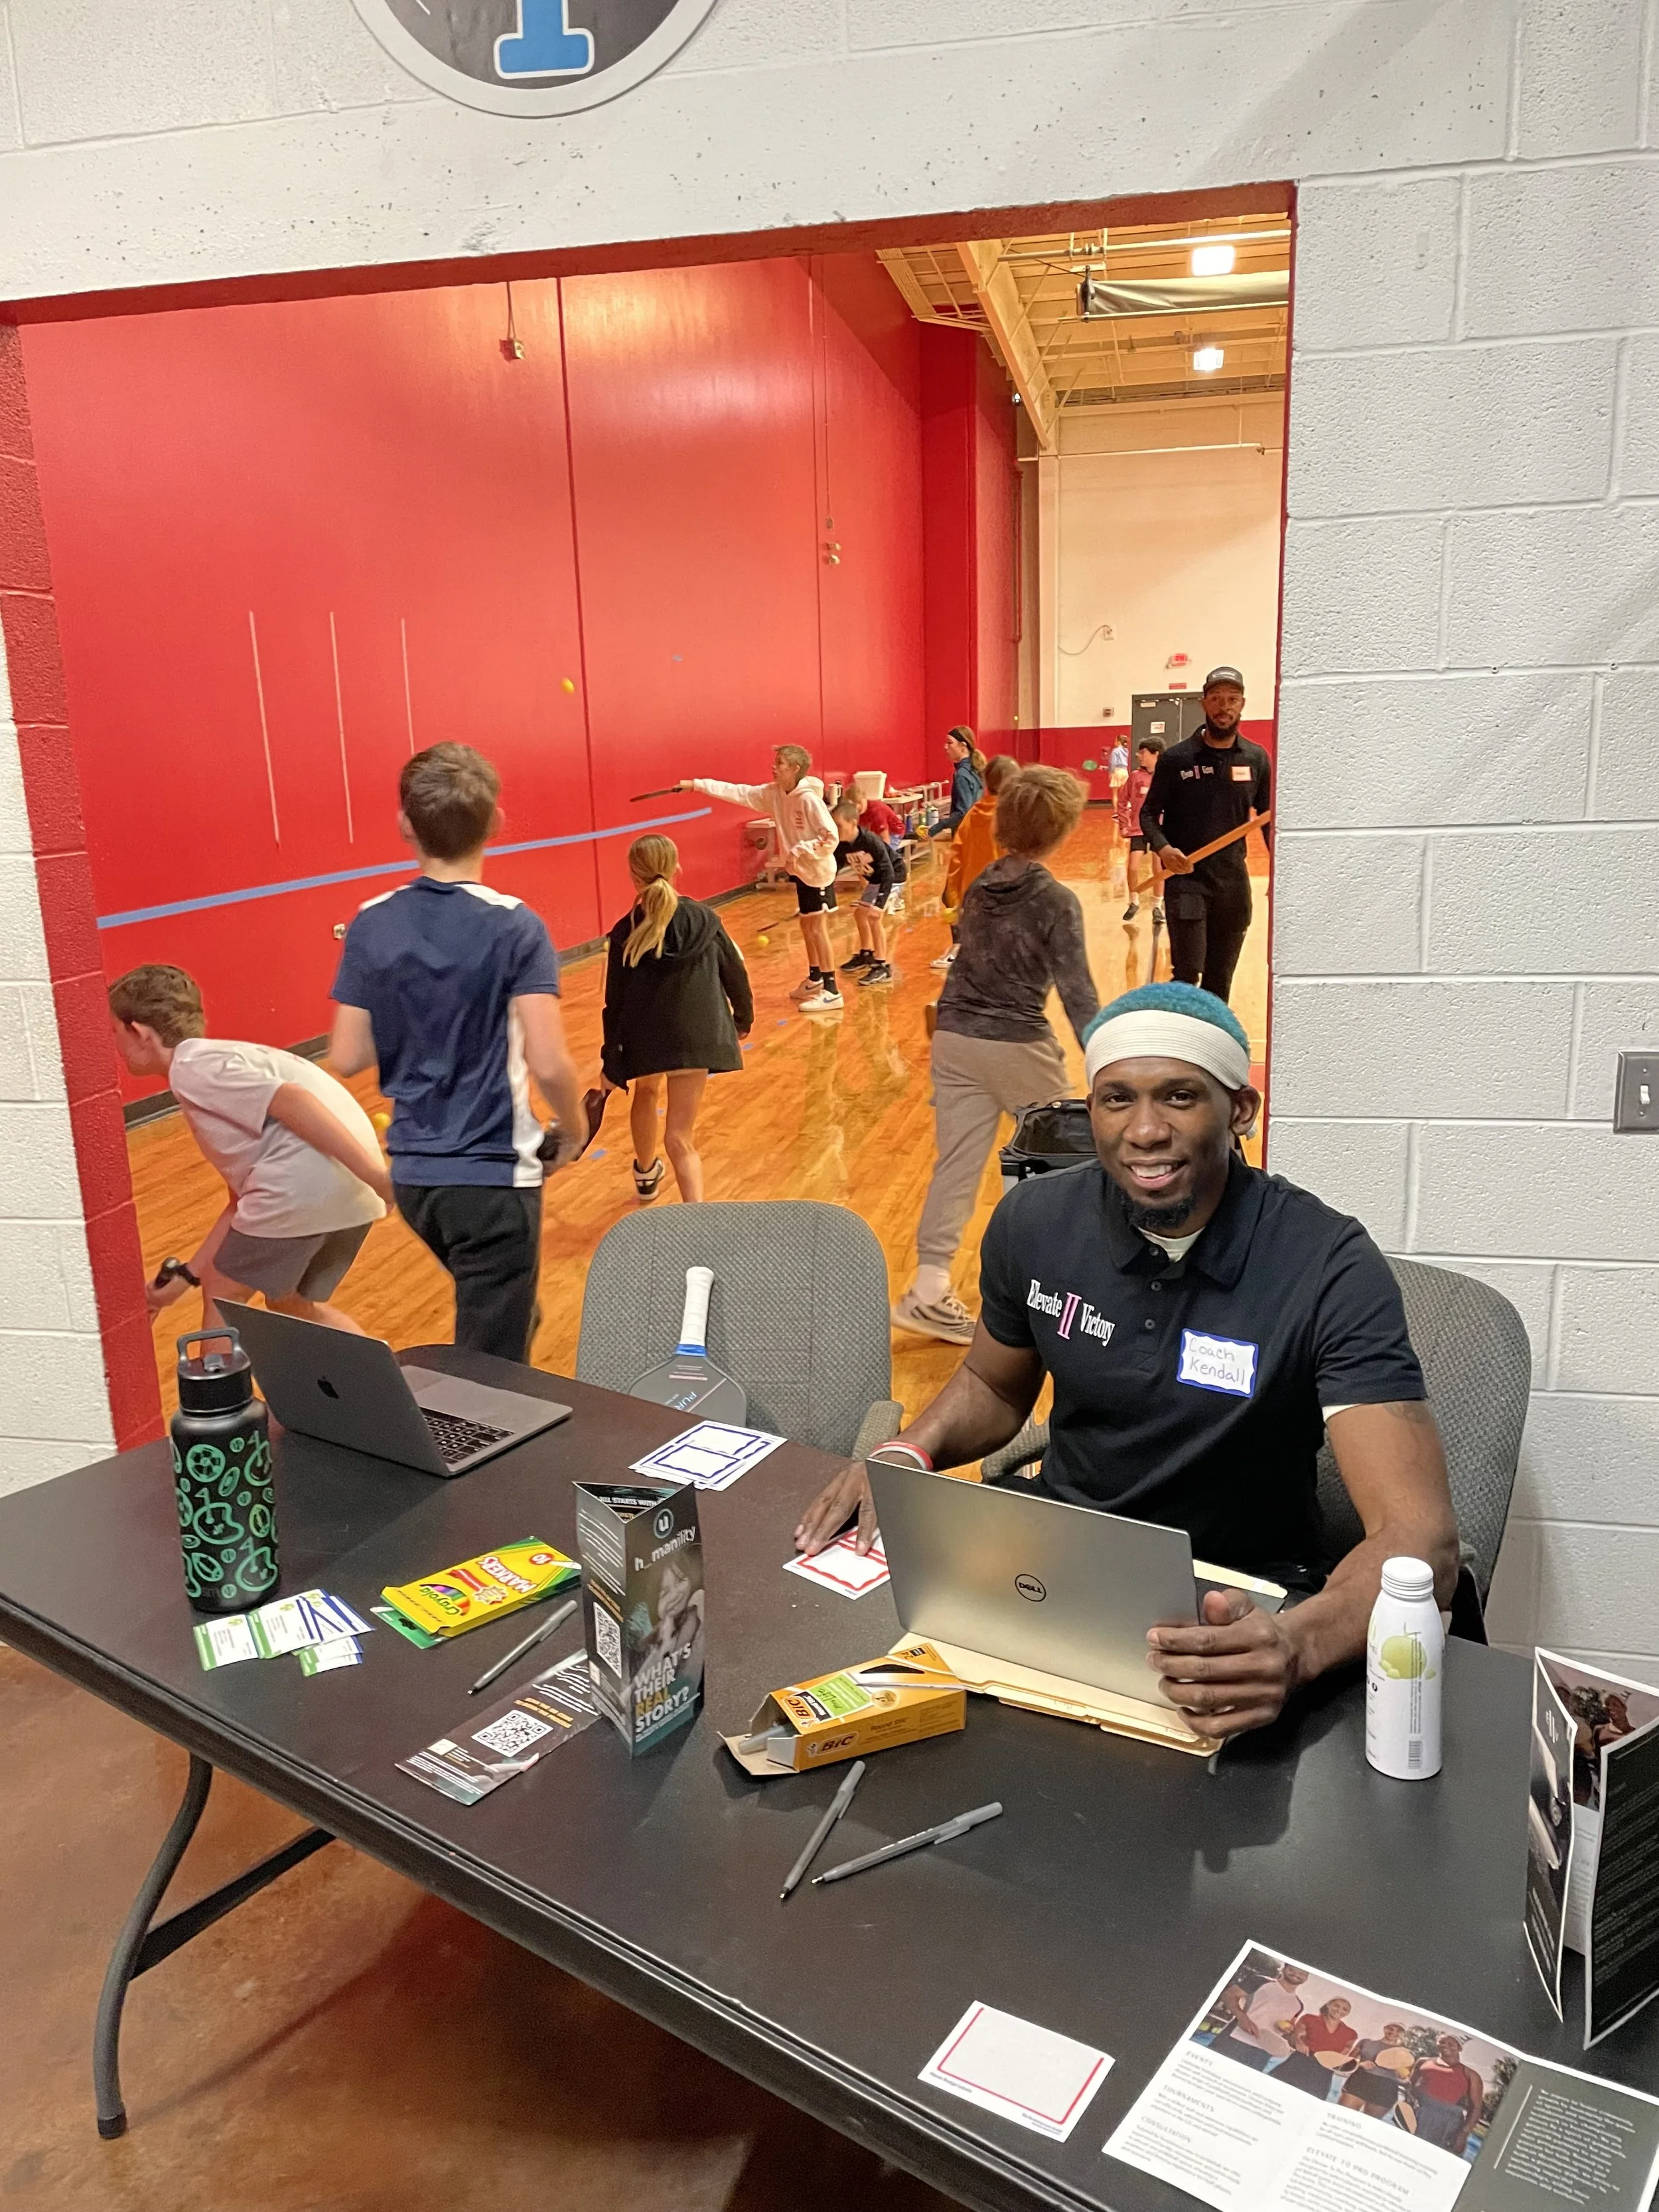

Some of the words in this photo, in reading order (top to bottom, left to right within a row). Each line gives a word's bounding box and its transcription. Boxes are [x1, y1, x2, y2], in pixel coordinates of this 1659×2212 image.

[1027, 1279, 1062, 1317] Elevate
[1080, 1303, 1115, 1347] Victory
[1189, 1337, 1235, 1361] Coach
[1190, 1360, 1245, 1386] Kendall
[476, 1556, 538, 1593] MARKERS
[1019, 1582, 1043, 1593] DELL
[420, 1587, 460, 1615] Crayola
[634, 1643, 691, 1688] WHAT'S
[634, 1668, 676, 1703] THEIR
[635, 1687, 670, 1719] REAL
[635, 1686, 689, 1733] STORY?
[787, 1698, 810, 1717] BIC
[821, 1735, 855, 1753] BIC
[1186, 2050, 1214, 2067] EVENTS
[1163, 2085, 1214, 2113] TOURNAMENTS
[1306, 2146, 1338, 2163] ELEVATE
[1370, 2173, 1410, 2197] PROGRAM
